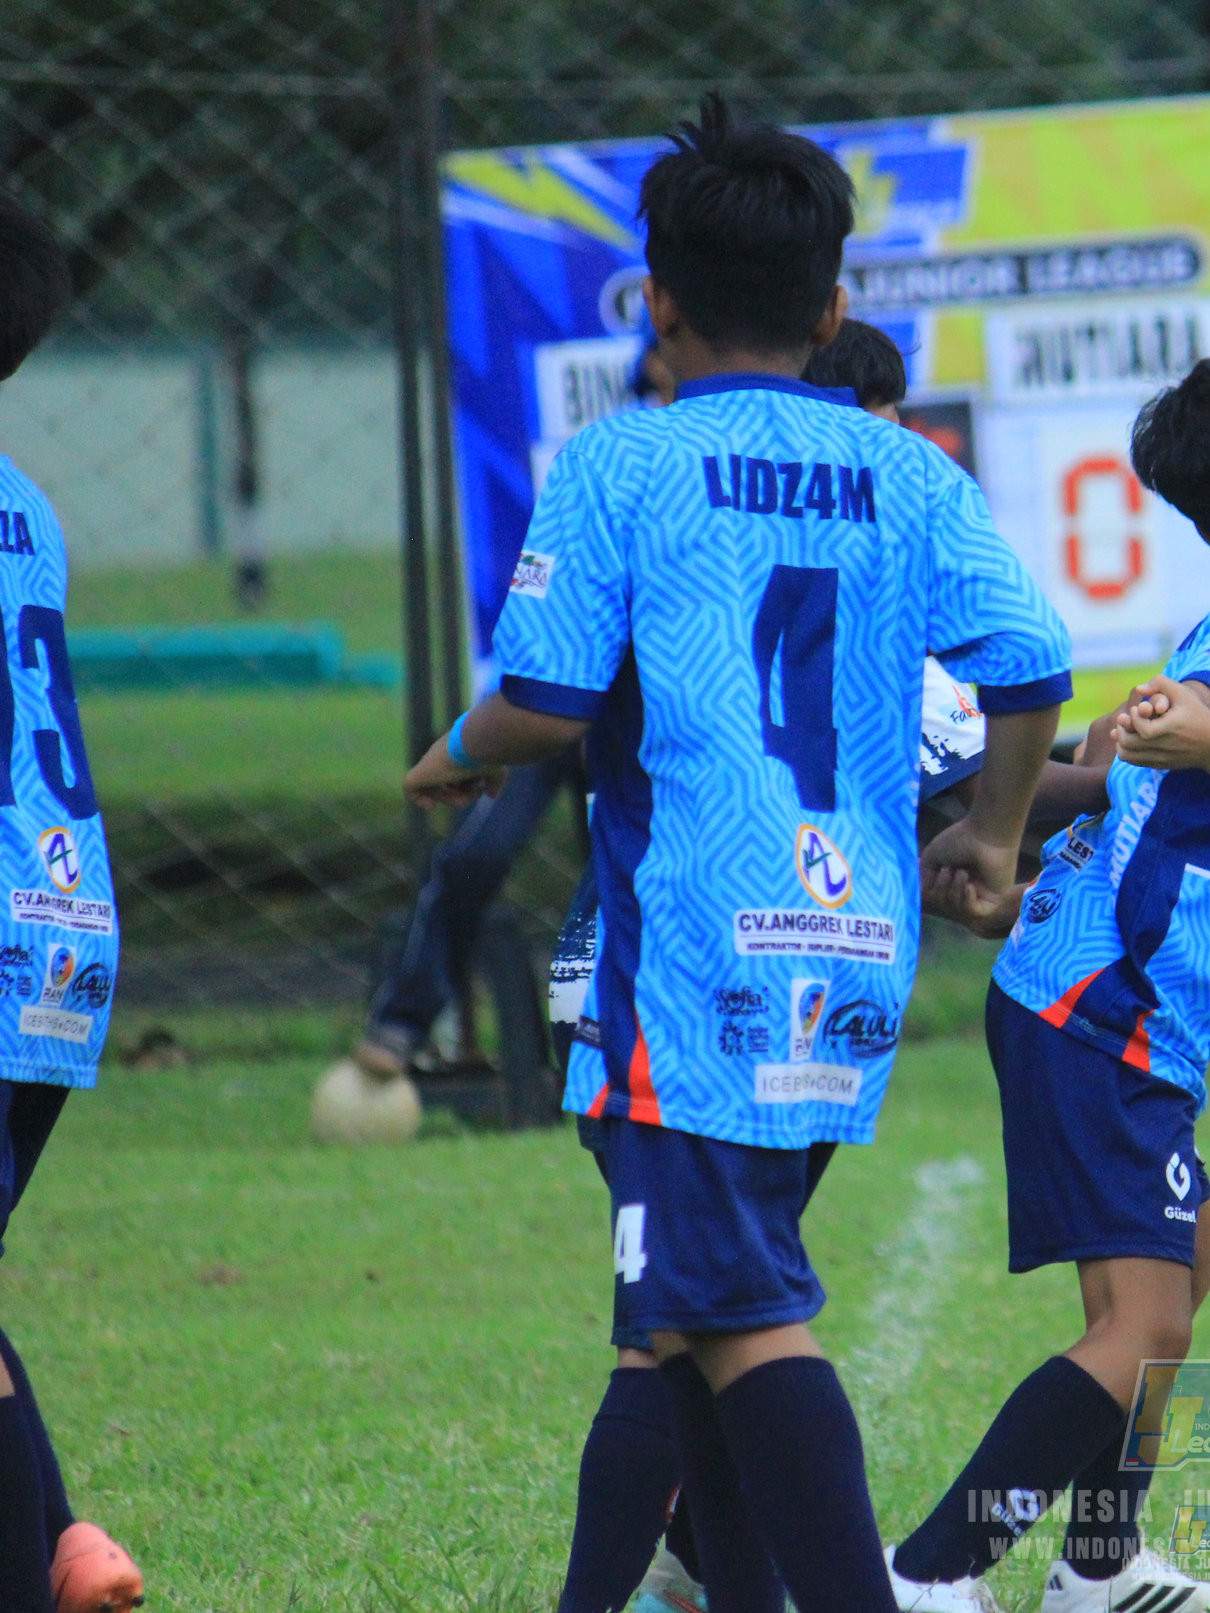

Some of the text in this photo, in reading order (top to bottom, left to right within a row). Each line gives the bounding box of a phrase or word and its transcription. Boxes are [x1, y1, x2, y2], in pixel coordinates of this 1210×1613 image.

[703, 455, 877, 523] LIDZ4M
[1062, 453, 1144, 600] 0
[753, 564, 840, 813] 4
[846, 919, 894, 943] LESTARI
[613, 1204, 648, 1284] 4
[1164, 1206, 1197, 1223] Güzel
